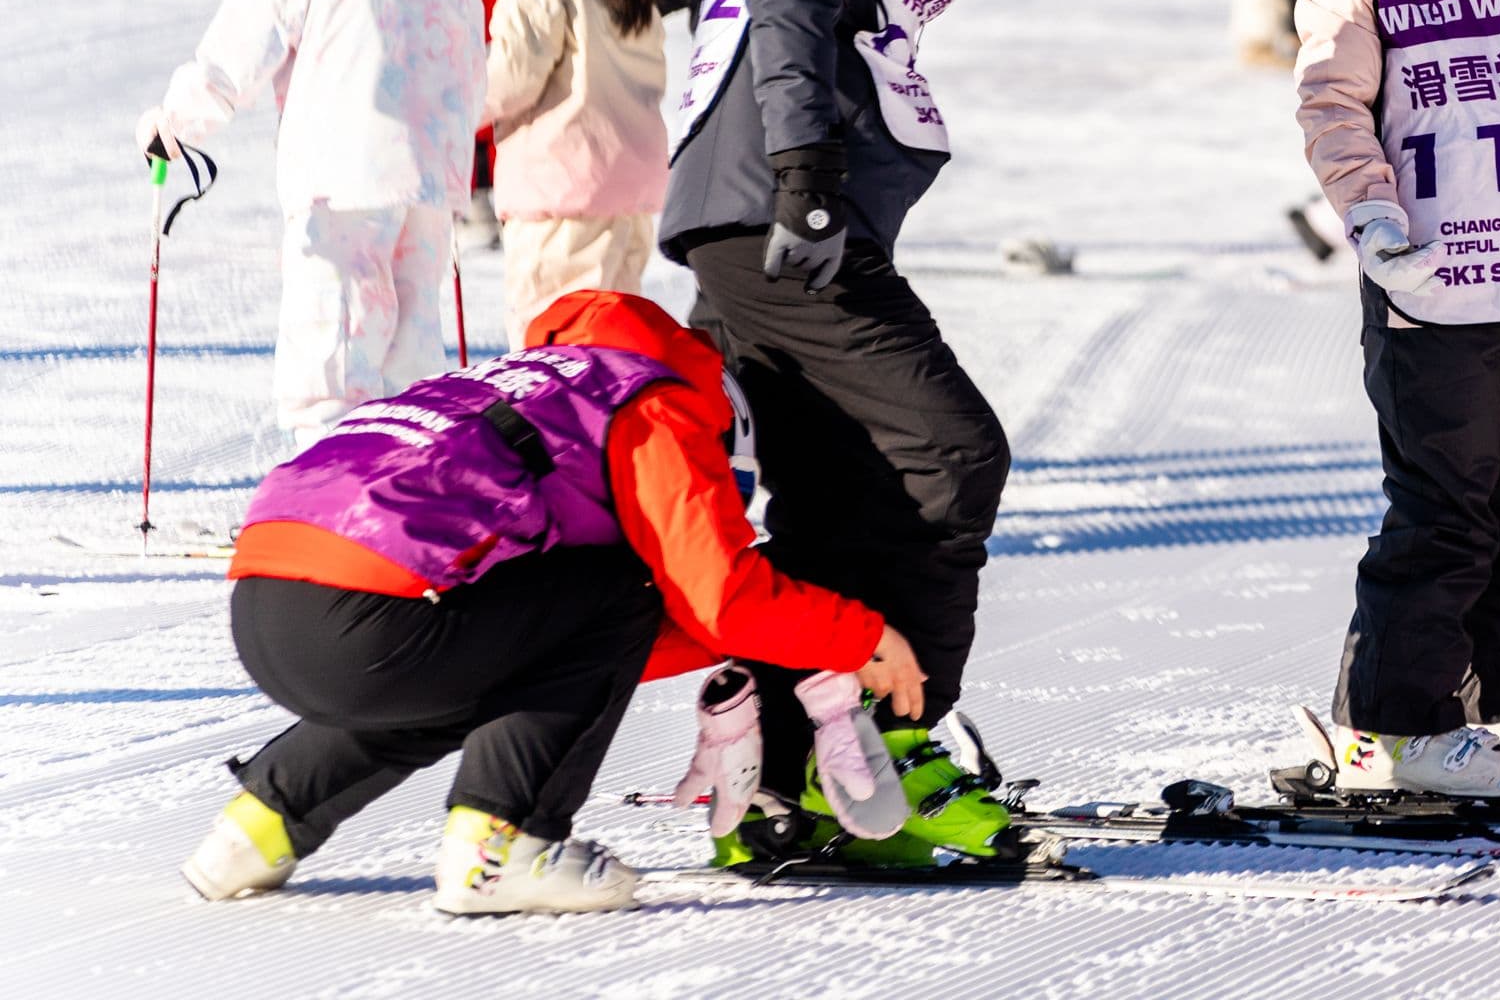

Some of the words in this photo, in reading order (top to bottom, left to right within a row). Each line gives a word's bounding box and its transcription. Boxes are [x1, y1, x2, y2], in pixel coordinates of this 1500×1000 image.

[1378, 0, 1462, 35] WILD
[1444, 239, 1500, 256] TIFUL
[1434, 264, 1486, 288] SKI
